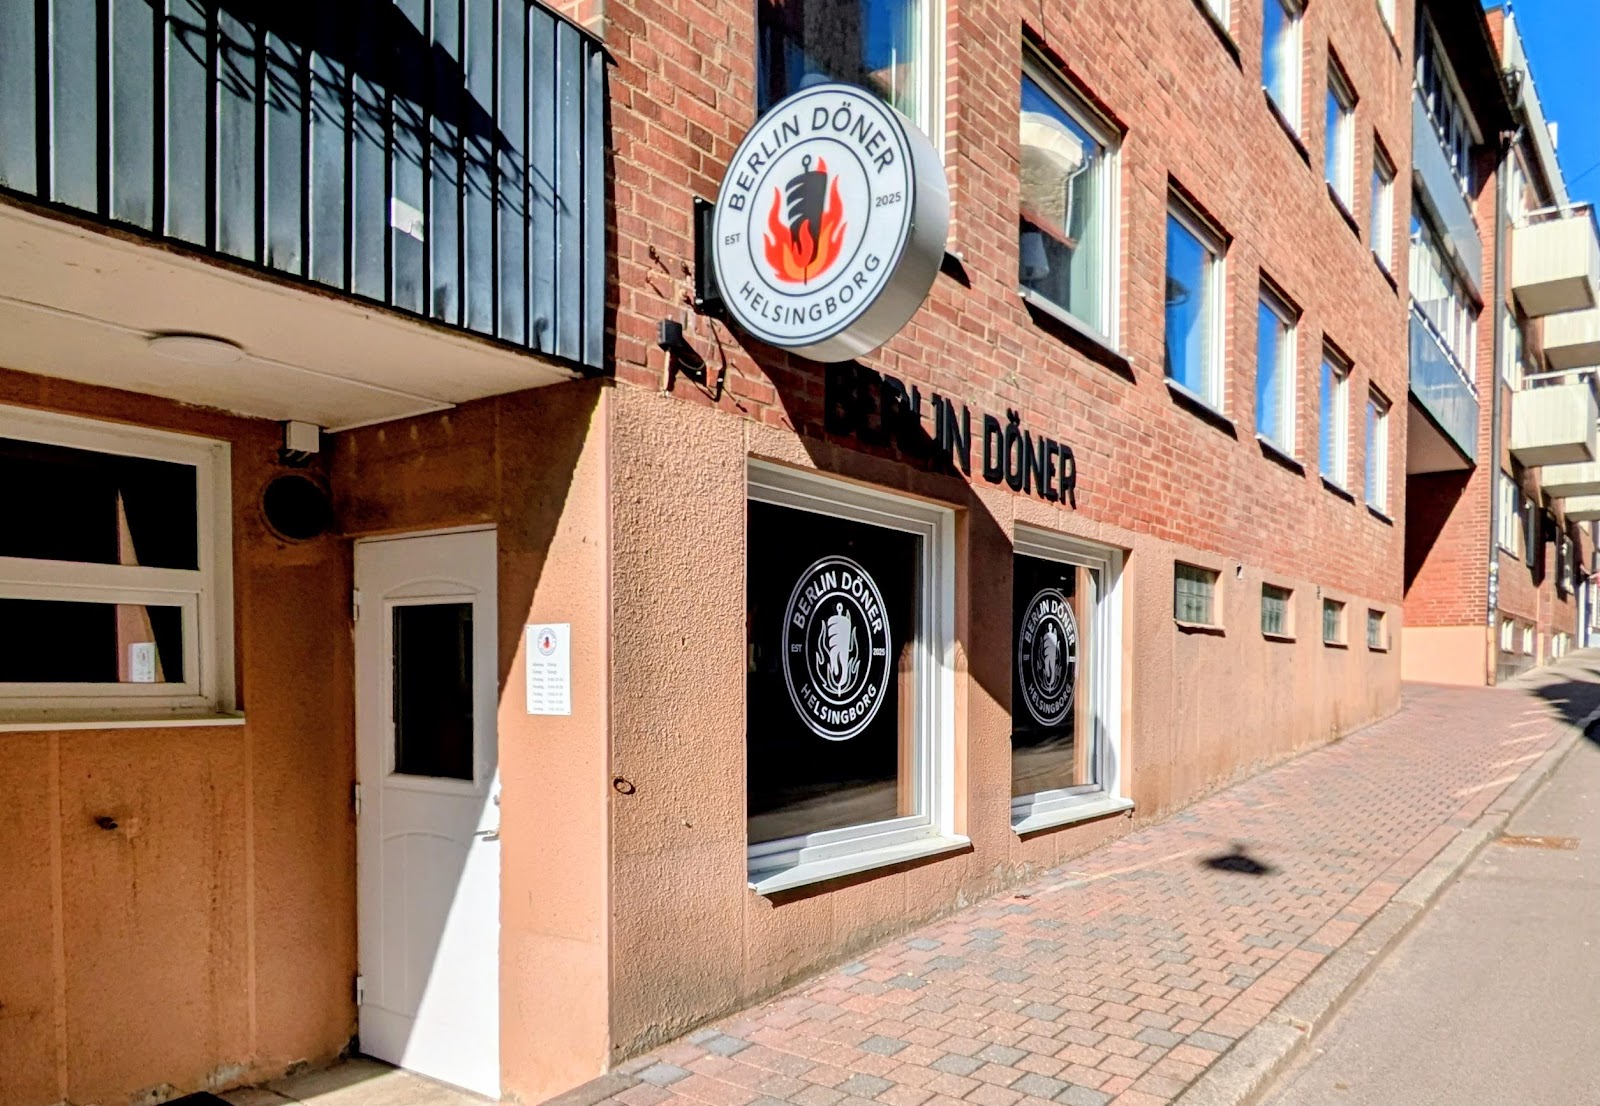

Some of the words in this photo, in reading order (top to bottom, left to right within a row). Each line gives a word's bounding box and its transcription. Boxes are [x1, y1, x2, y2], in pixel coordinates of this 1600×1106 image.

[728, 115, 801, 212] BERLIN
[811, 101, 895, 174] DÖNER
[875, 191, 902, 208] 2025
[724, 233, 741, 246] EST
[739, 253, 880, 325] HELSINGBORG
[824, 363, 971, 477] BERLIN
[982, 407, 1077, 510] DÖNER
[793, 570, 838, 629] BERLIN
[841, 572, 883, 634] DÖNER
[1024, 599, 1049, 643] BERLIN
[1051, 600, 1075, 646] DÖNER
[791, 643, 802, 653] EST
[801, 683, 877, 725] HELSINGBORG
[1028, 682, 1072, 714] HELSINGBORG
